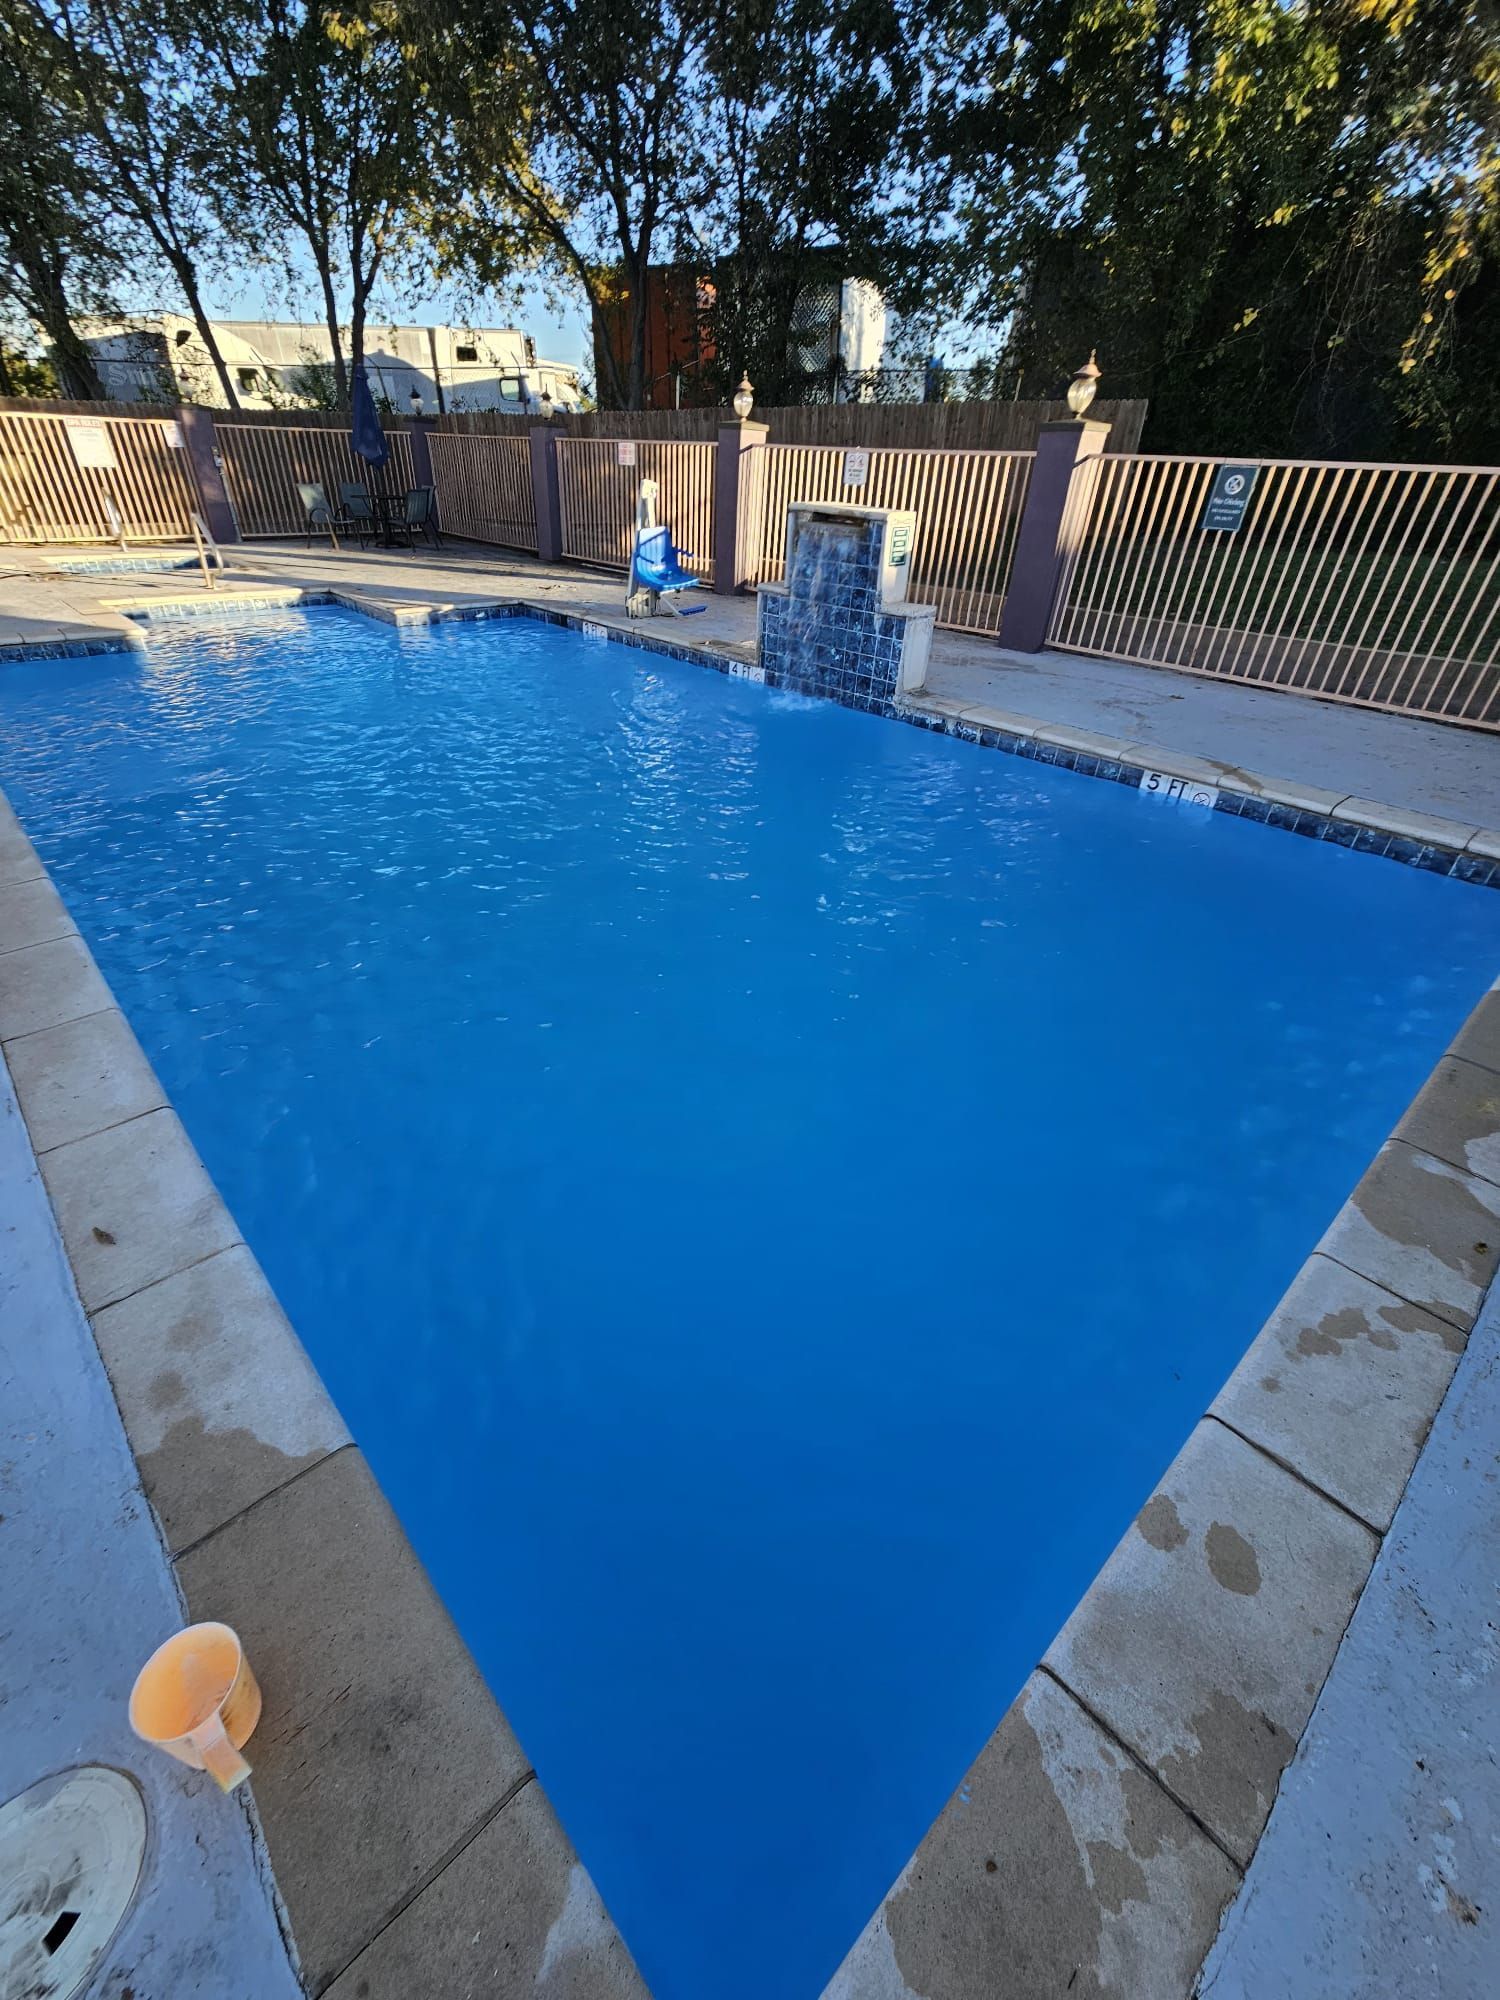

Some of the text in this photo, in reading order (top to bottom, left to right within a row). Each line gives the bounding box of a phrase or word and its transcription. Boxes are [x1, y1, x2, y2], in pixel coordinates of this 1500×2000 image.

[732, 663, 752, 679] 4 FT
[1147, 773, 1189, 800] 5 FT
